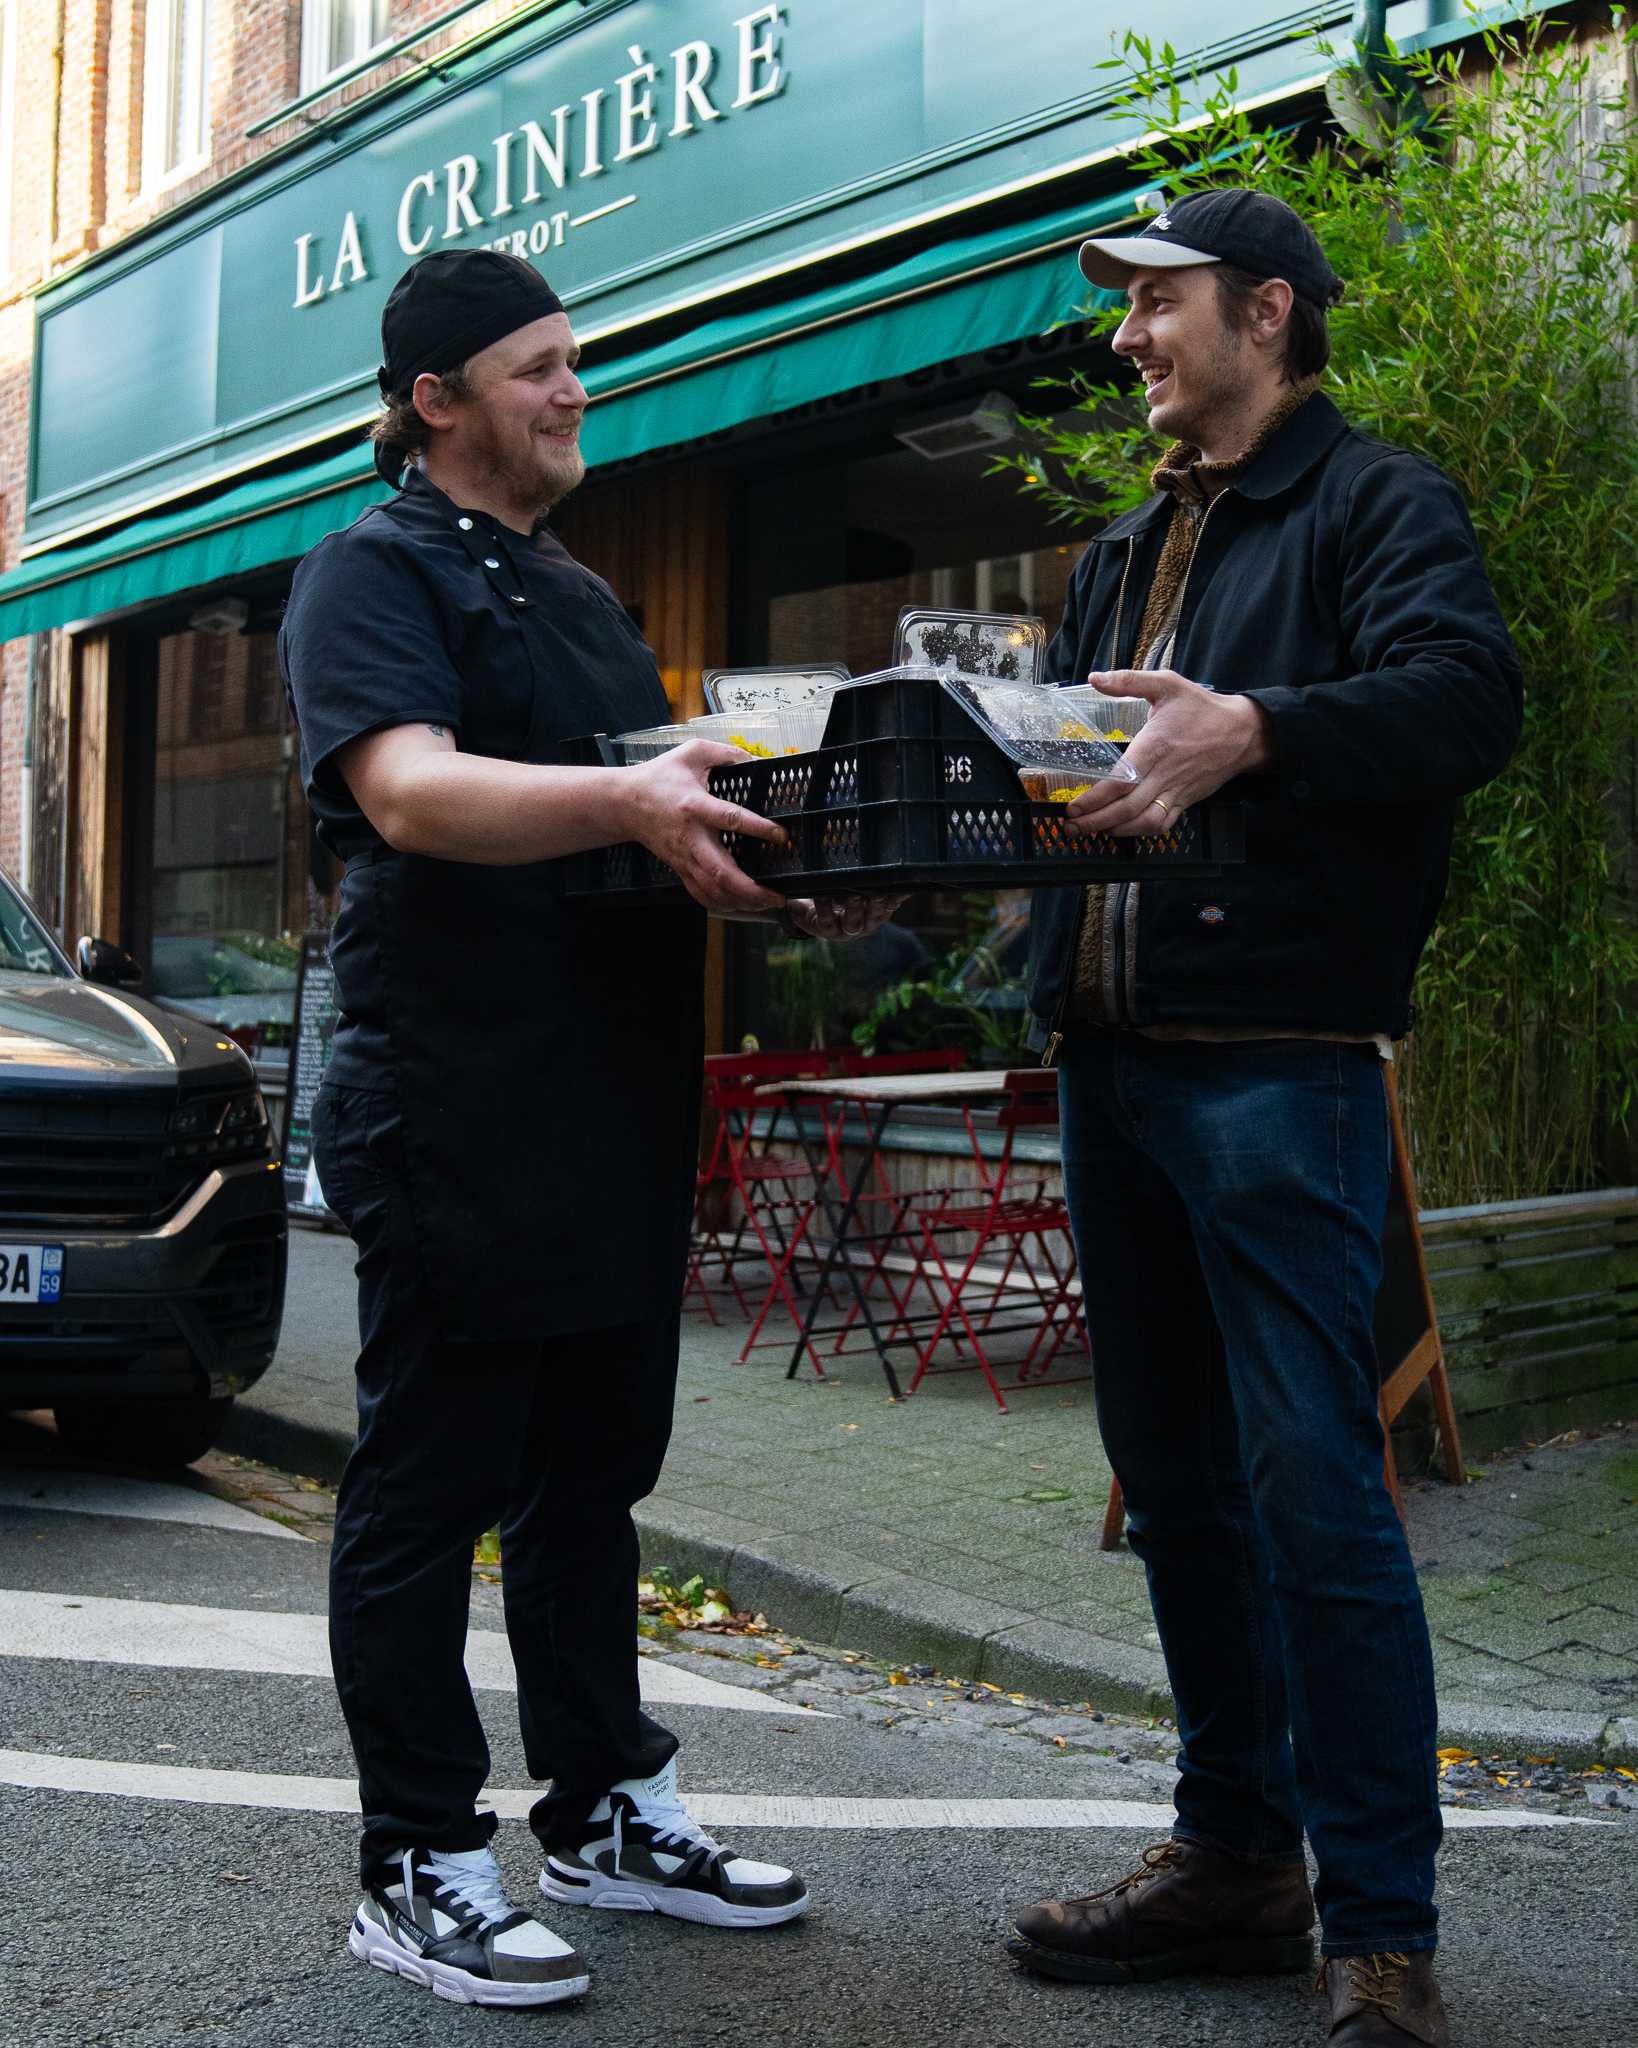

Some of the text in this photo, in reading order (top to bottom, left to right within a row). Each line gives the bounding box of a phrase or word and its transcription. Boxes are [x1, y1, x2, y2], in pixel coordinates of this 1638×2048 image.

[292, 4, 784, 308] LA CRINIÈRE
[480, 210, 569, 260] TROT
[41, 1274, 60, 1293] 59
[647, 1774, 670, 1791] FASHION
[653, 1783, 670, 1797] SPORT
